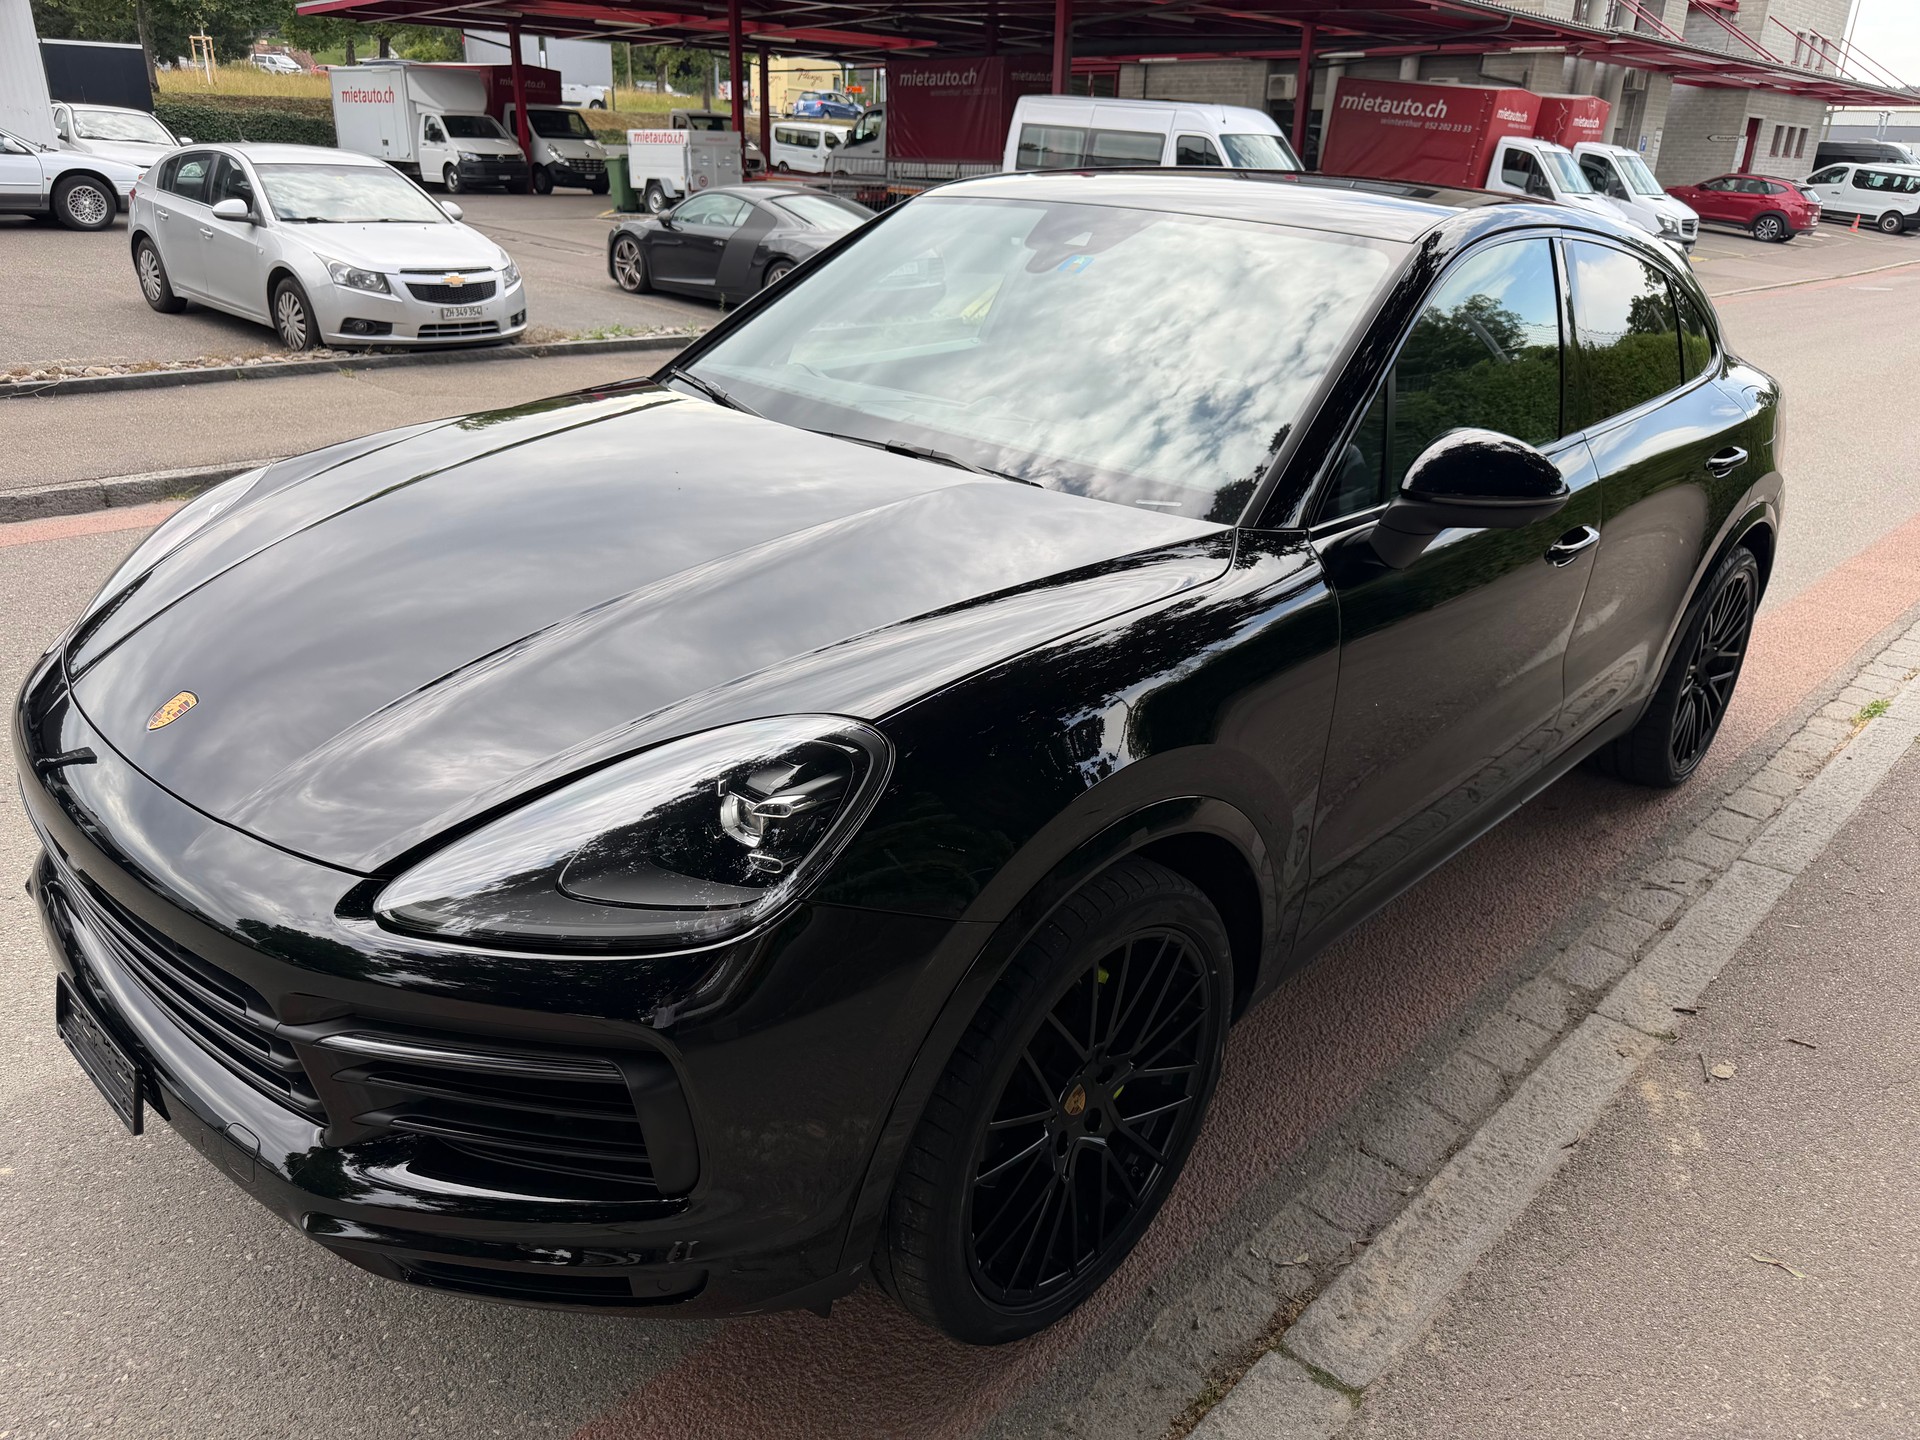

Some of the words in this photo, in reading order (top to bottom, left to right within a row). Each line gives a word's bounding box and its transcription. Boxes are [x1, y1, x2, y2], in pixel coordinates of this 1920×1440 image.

[900, 67, 977, 86] mietauto.ch
[341, 85, 395, 104] mietauto.ch
[1340, 93, 1447, 118] mietauto.ch
[1497, 107, 1528, 123] mietauto.ch
[1380, 117, 1423, 129] winterthur
[1424, 121, 1438, 130] 052
[1452, 123, 1462, 133] 33
[1462, 125, 1473, 134] 33
[633, 130, 684, 144] mietauto.ch
[446, 307, 455, 317] ZH
[456, 306, 468, 317] 349
[469, 305, 481, 316] 354
